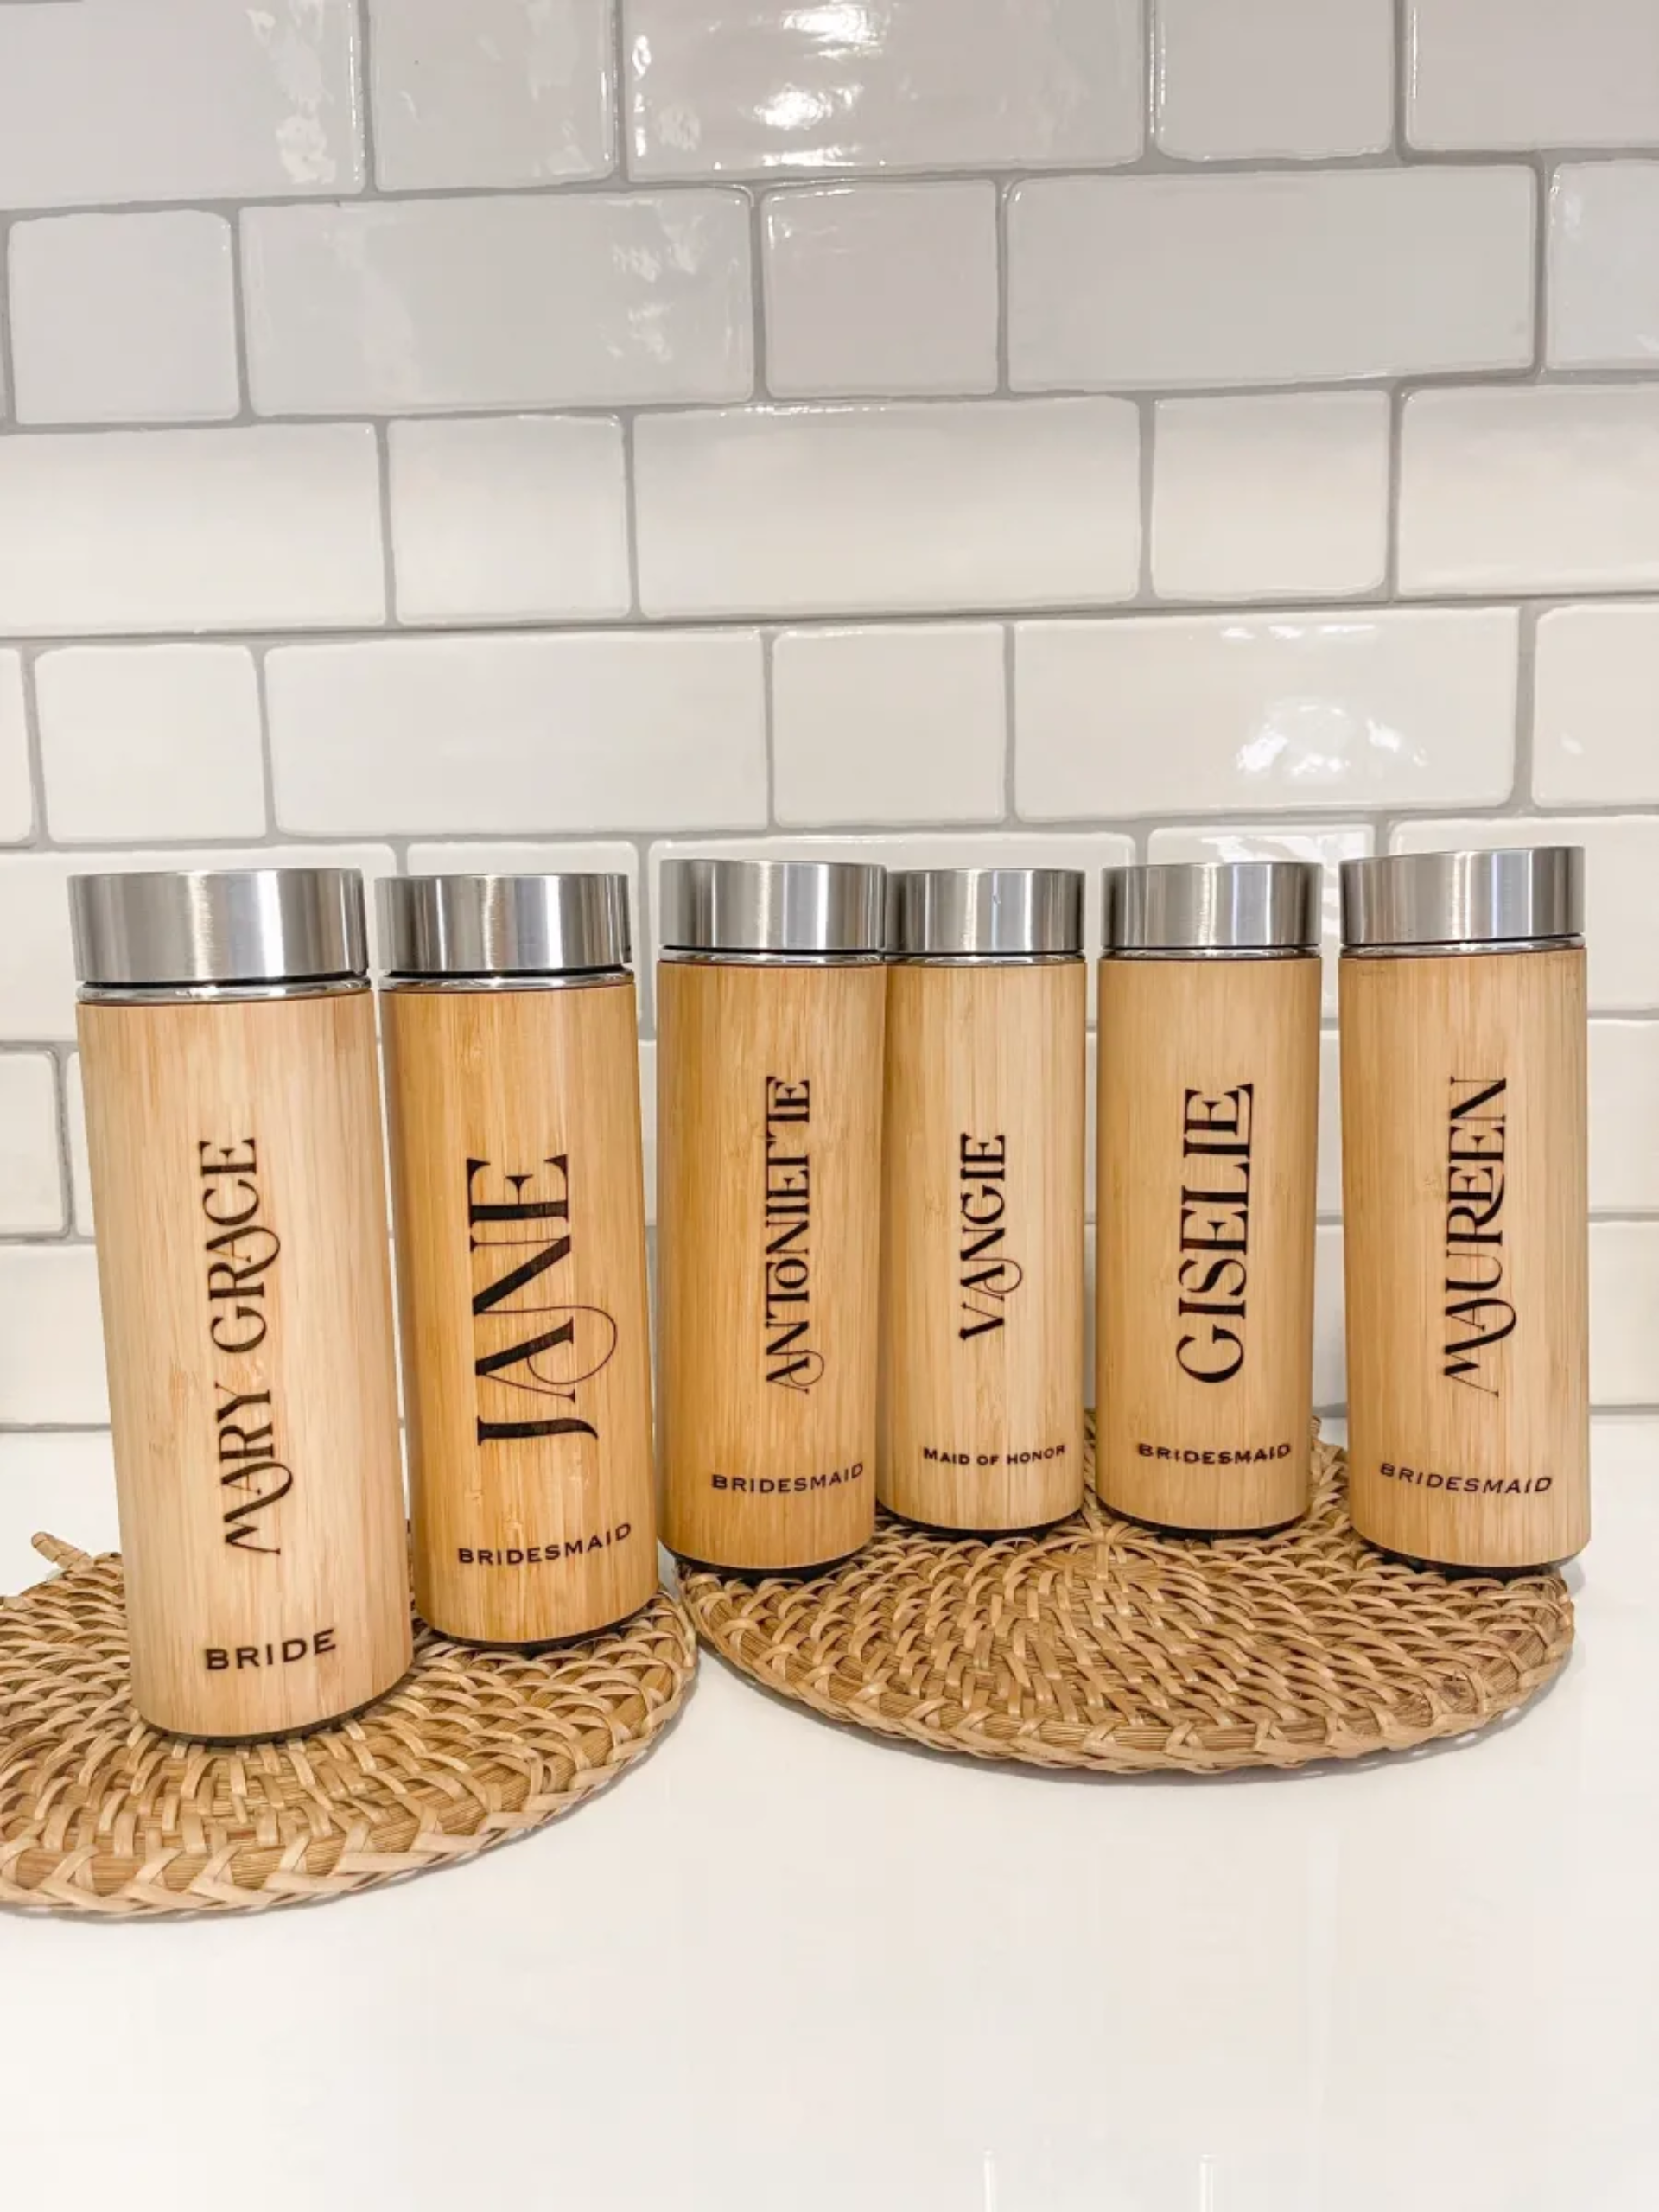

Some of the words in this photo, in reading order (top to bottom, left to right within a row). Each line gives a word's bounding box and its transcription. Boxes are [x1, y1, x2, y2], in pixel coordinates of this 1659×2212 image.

[198, 1137, 282, 1354] GRACE
[466, 1154, 618, 1446] JANE
[764, 1076, 824, 1395] ANTONIETTE
[958, 1132, 1023, 1341] VANGIE
[1175, 1083, 1254, 1383] GISELLE
[1443, 1076, 1518, 1398] MAUREEN
[214, 1381, 295, 1555] MARY
[710, 1462, 864, 1494] BRIDESMAID
[922, 1446, 971, 1466] MAID
[976, 1453, 1000, 1467] OF
[1007, 1443, 1066, 1465] HONOR
[1137, 1442, 1292, 1465] BRIDESMAID
[1379, 1462, 1552, 1495] BRIDESMAID
[457, 1522, 632, 1566] BRIDESMAID
[204, 1628, 337, 1671] BRIDE
